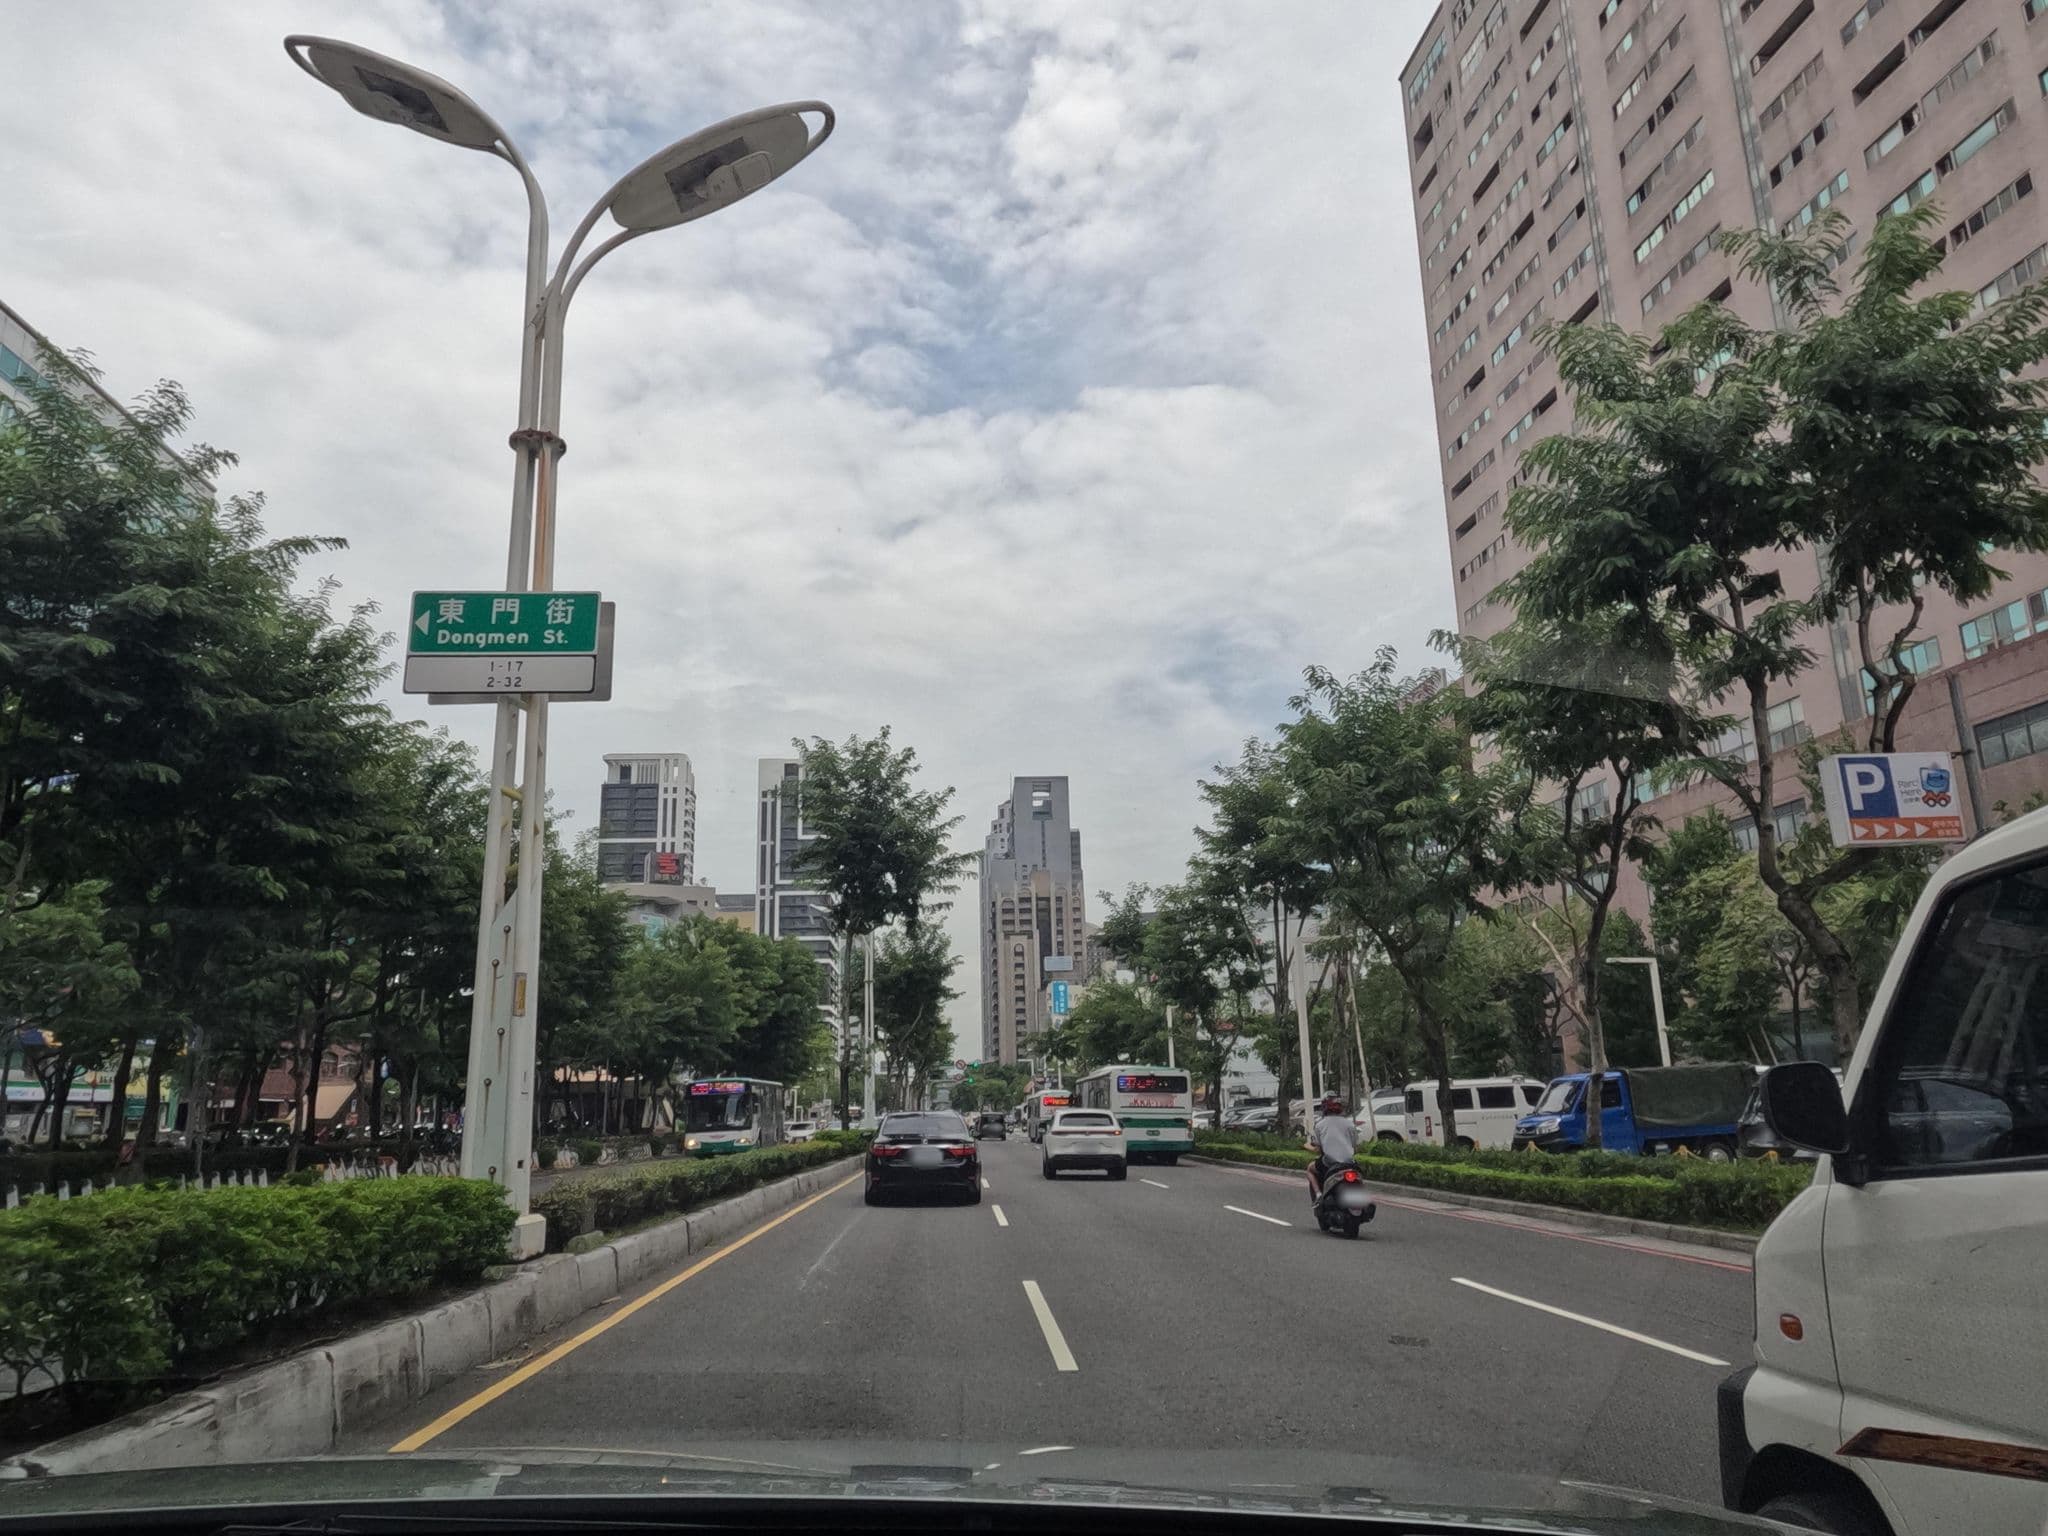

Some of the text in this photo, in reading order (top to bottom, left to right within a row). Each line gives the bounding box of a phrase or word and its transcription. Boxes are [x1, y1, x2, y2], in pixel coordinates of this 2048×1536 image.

[436, 598, 575, 625] 東門街
[437, 629, 568, 648] Dongmen St.
[490, 660, 523, 673] 1-17
[486, 676, 522, 688] 2-32
[1844, 763, 1885, 811] P
